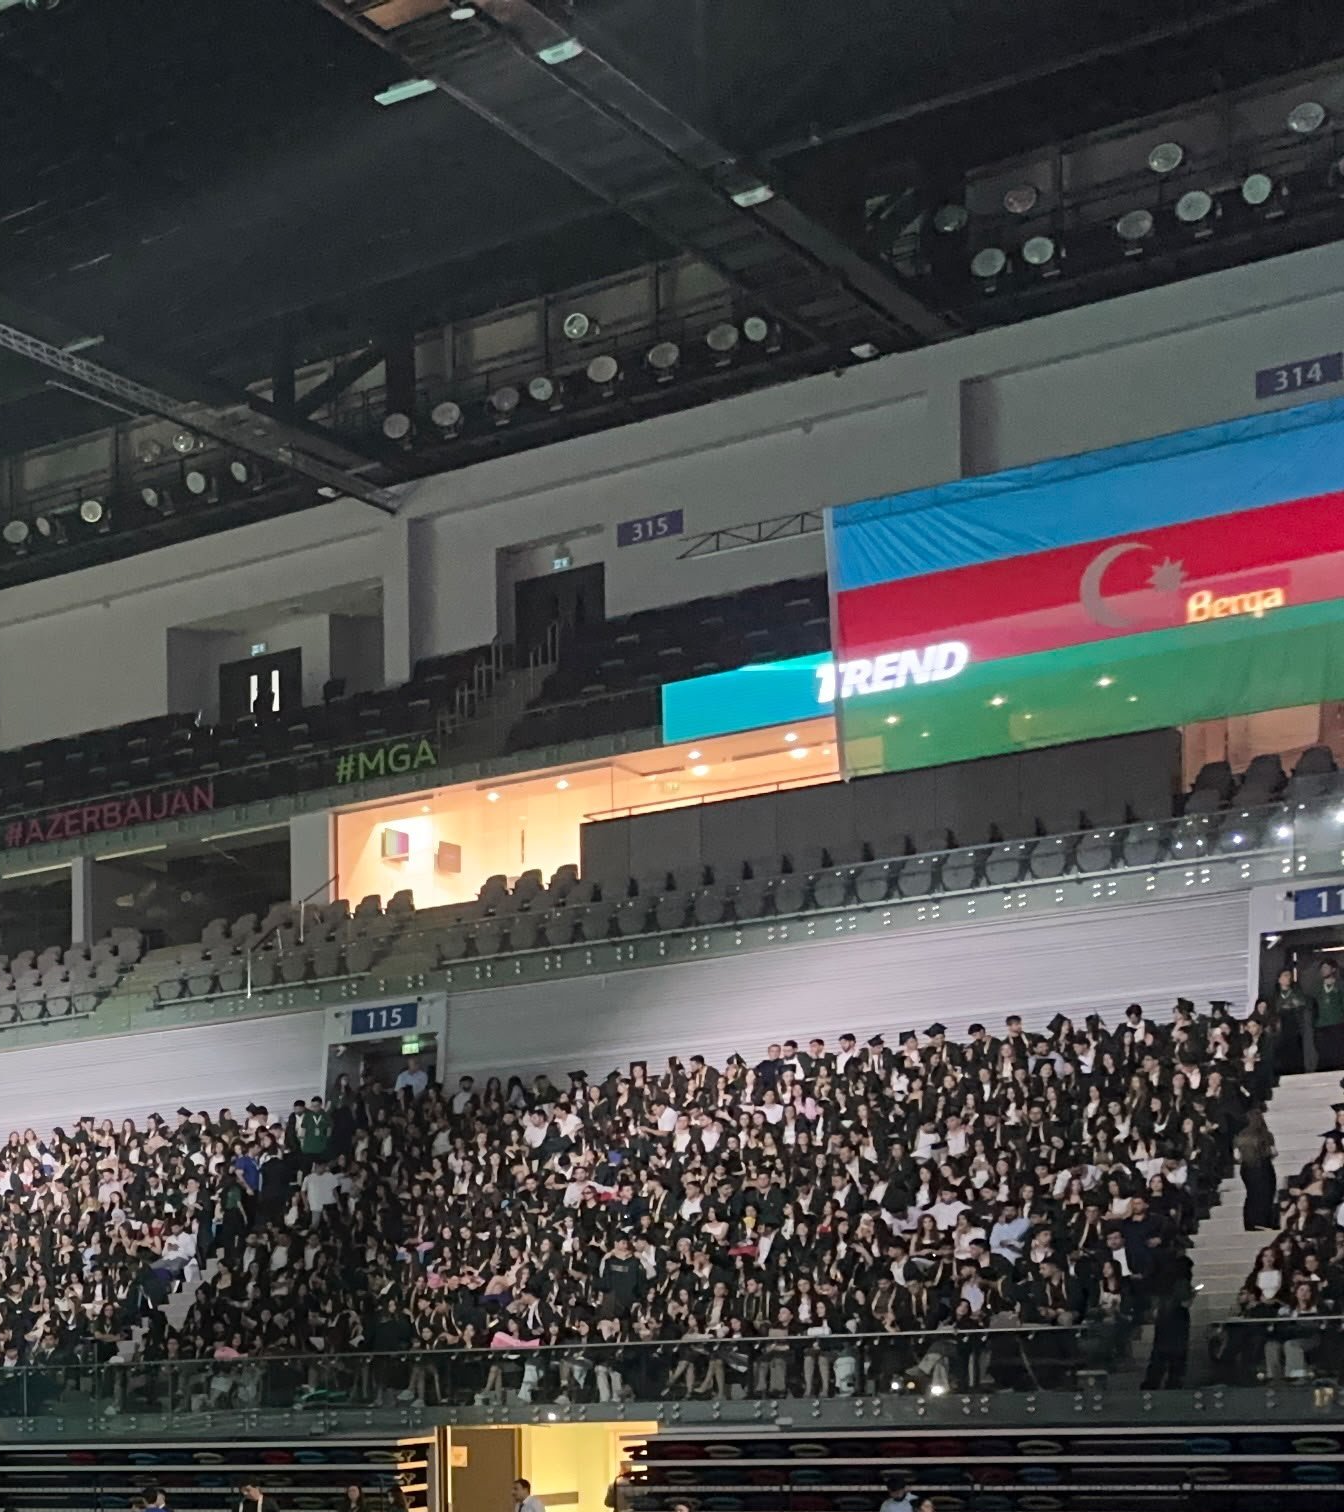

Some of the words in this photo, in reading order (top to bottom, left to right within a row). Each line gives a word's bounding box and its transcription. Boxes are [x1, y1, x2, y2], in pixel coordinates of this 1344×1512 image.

[1273, 362, 1322, 391] 314
[631, 517, 668, 541] 315
[815, 640, 970, 703] TREND
[335, 738, 437, 784] #MGA
[4, 787, 217, 847] #AZERBAIJAN
[1317, 890, 1344, 913] 11
[367, 1008, 402, 1029] 115
